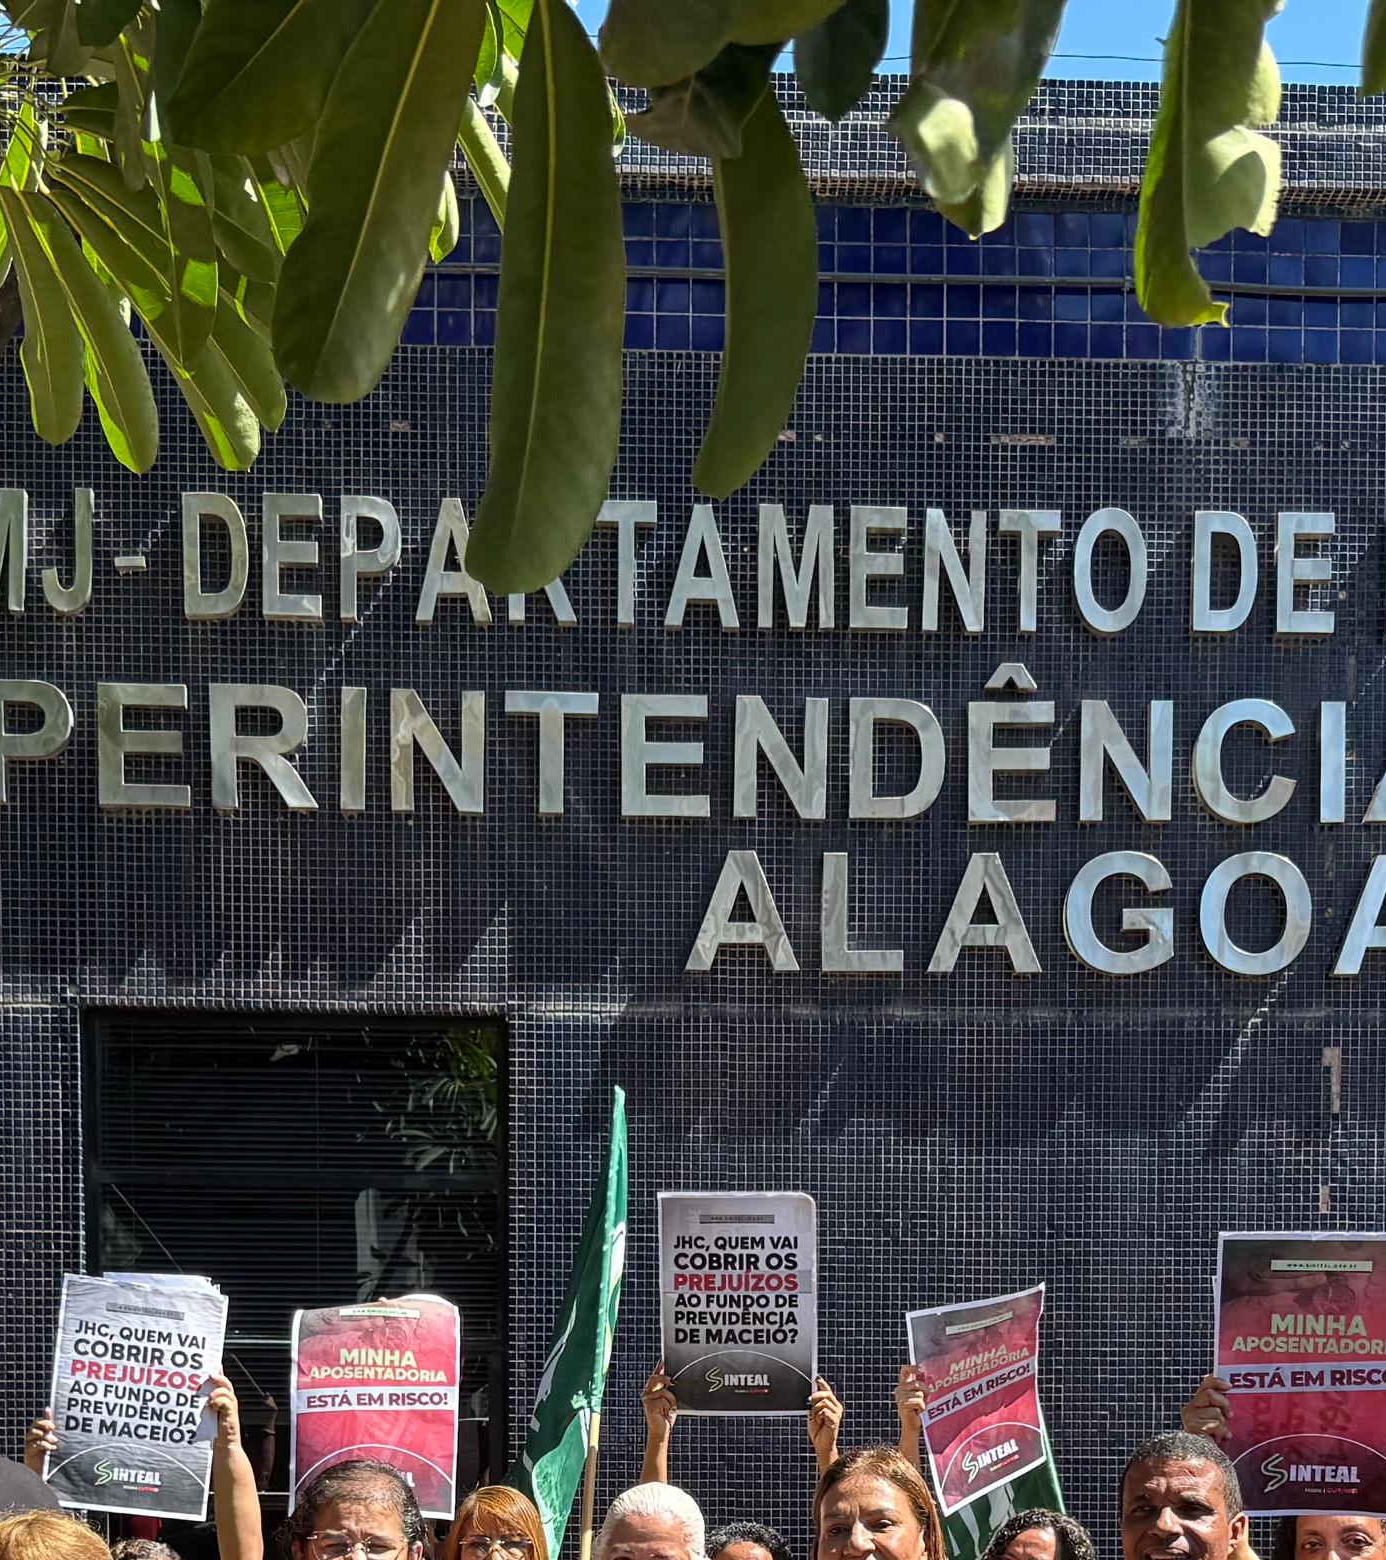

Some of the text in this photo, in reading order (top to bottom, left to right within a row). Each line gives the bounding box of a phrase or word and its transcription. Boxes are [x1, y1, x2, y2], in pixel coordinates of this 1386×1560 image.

[1193, 509, 1336, 637] DE
[674, 1236, 798, 1252] JHC, QUEM VAI
[674, 1252, 798, 1271] COBRIR OS
[674, 1269, 798, 1292] PREJUÍZOS
[675, 1294, 799, 1309] AO FUNDO DE
[674, 1308, 798, 1328] PREVIDÊNCIA
[1271, 1313, 1367, 1337] MINHA
[75, 1320, 206, 1350] JHC, QUEM VAI
[675, 1326, 798, 1344] DE MACEIÓ?
[73, 1338, 204, 1370] COBRIR OS
[340, 1348, 417, 1368] MINHA
[949, 1343, 1007, 1376] MINHA
[70, 1358, 202, 1392] PREJUÍZOS
[310, 1367, 448, 1383] APOSENTADORIA
[706, 1366, 770, 1392] SINTEAL
[928, 1347, 1030, 1394] APOSENTADORIA
[1230, 1366, 1286, 1389] ESTÁ
[1291, 1370, 1325, 1388] EM
[70, 1380, 200, 1409] AO FUNDO DE
[306, 1390, 448, 1409] ESTÁ EM RISCO!
[928, 1363, 1031, 1421] ESTÁ EM RISCO!
[65, 1415, 92, 1434] DE
[67, 1397, 198, 1428] PREVIDÊNCIA
[94, 1458, 162, 1486] SINTEAL
[963, 1438, 1019, 1484] SINTEAL
[1261, 1453, 1361, 1493] SINTEAL
